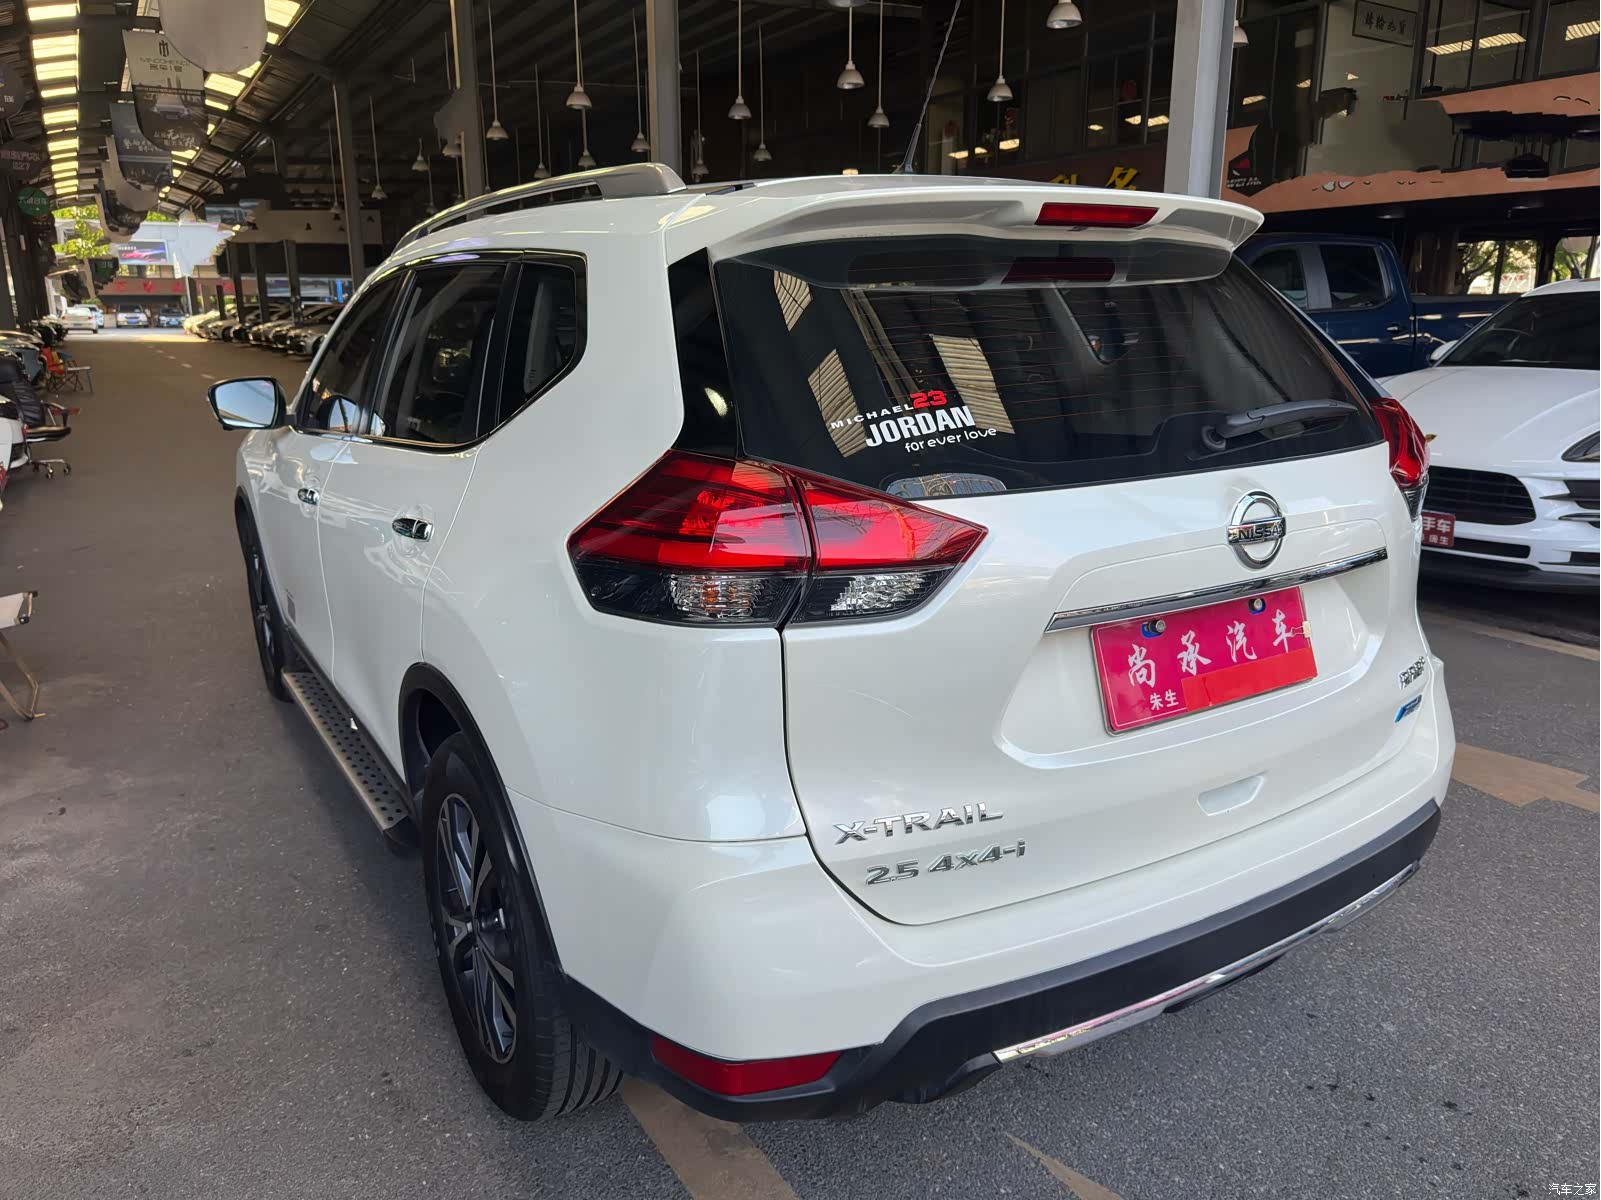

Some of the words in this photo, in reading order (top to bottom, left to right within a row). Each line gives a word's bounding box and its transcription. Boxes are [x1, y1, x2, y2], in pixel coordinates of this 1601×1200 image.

[831, 404, 914, 430] MICHAEL
[910, 390, 948, 409] 23
[865, 405, 976, 448] JORDAN
[965, 428, 997, 441] love
[1127, 608, 1292, 689] 尚承汽车
[1150, 688, 1179, 711] 朱生
[833, 802, 1005, 845] X-TRAIL
